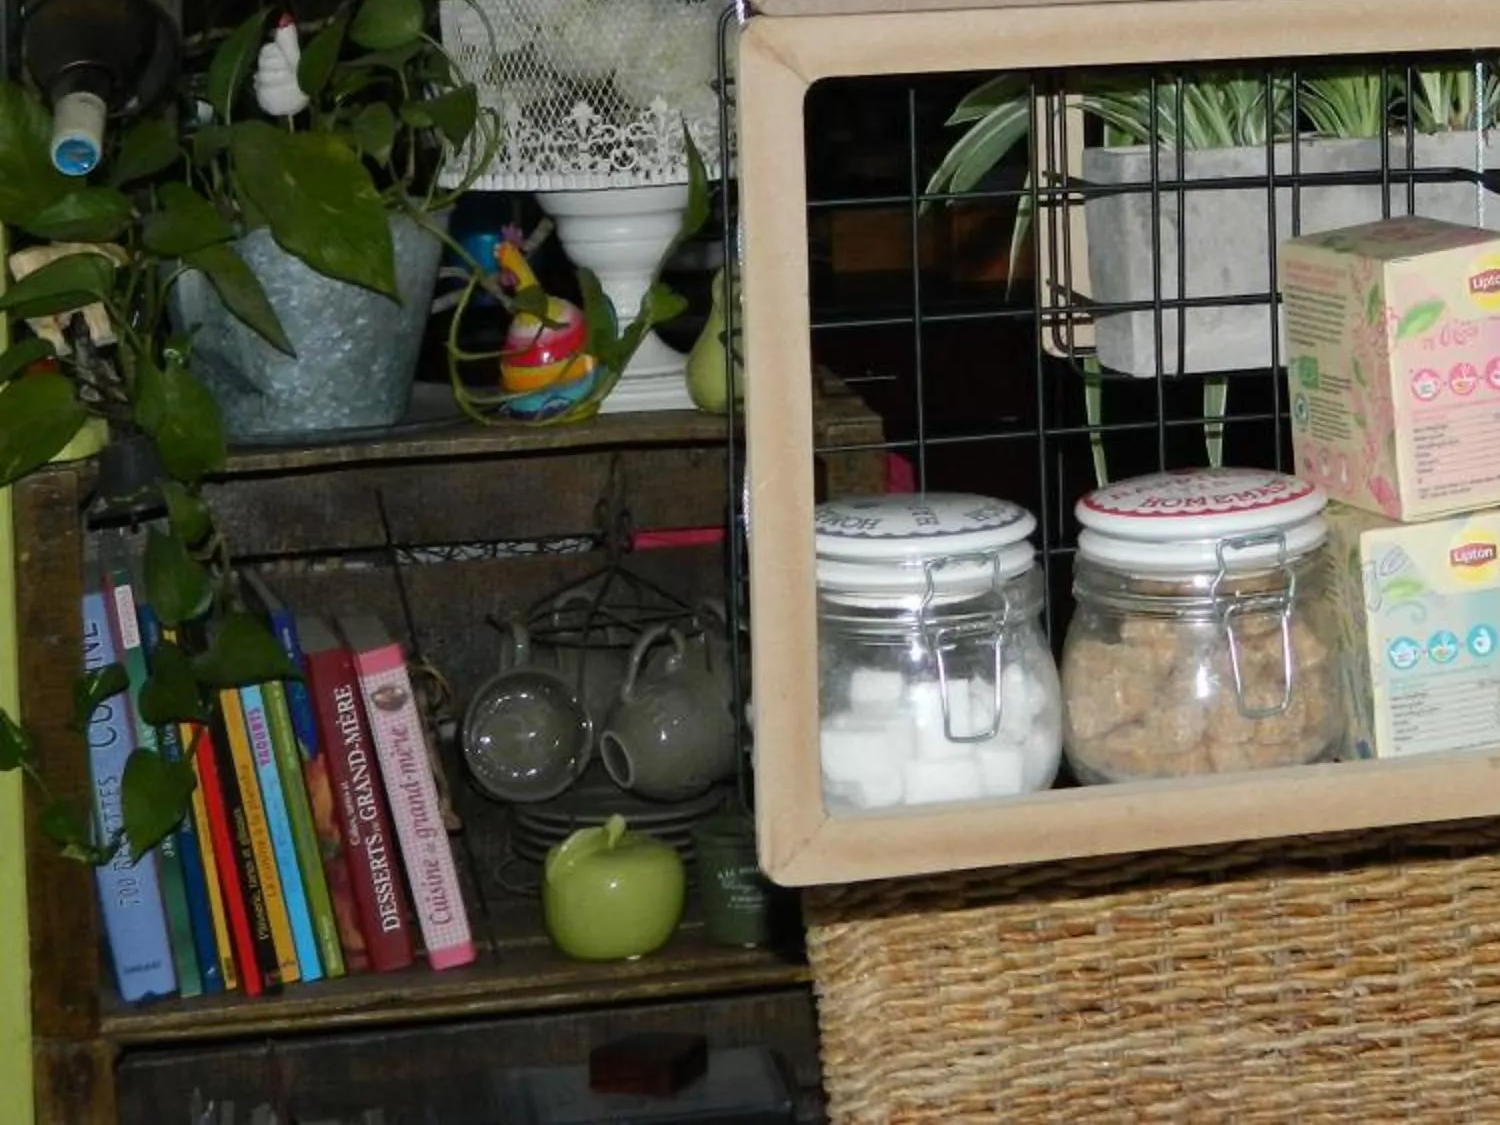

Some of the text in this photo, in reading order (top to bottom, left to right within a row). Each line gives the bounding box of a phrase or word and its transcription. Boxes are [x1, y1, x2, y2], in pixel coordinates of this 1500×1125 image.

[1452, 545, 1496, 566] Lipton
[332, 683, 379, 821] GRAND-MÈRE
[391, 726, 437, 841] grand-mère
[369, 834, 401, 933] DESSERTS
[425, 858, 450, 926] Cuisine
